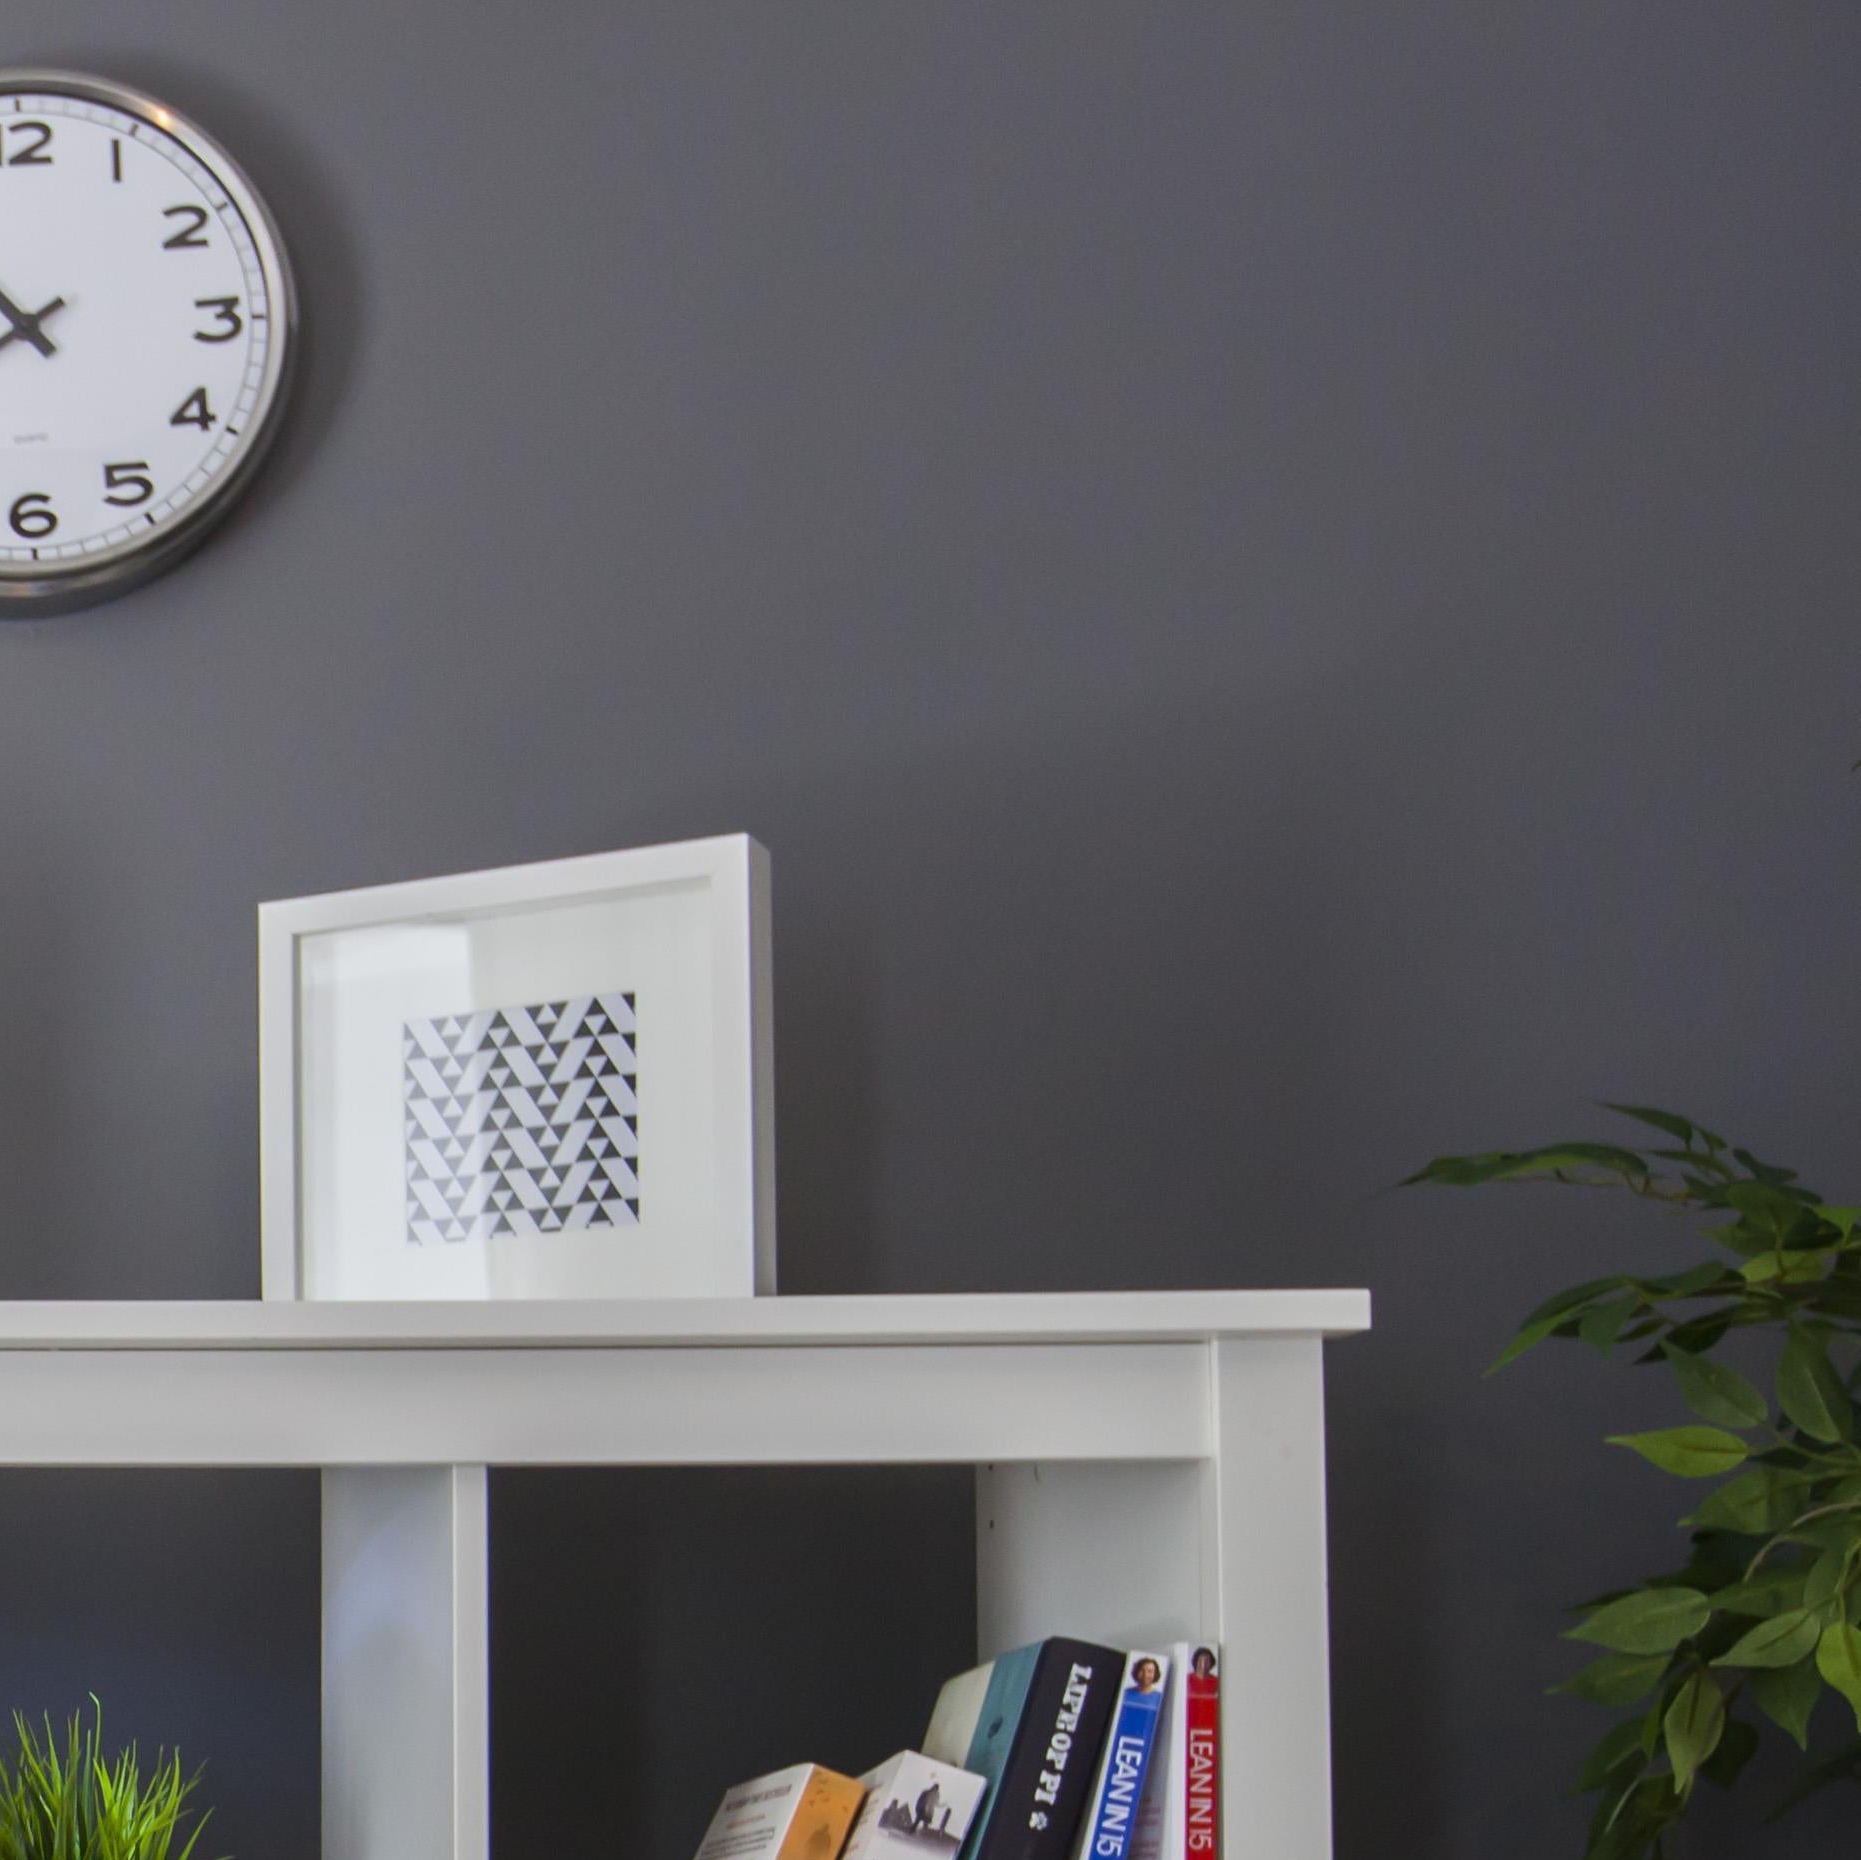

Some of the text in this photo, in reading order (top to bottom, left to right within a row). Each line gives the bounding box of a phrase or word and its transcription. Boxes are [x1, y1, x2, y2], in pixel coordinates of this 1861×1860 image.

[111, 138, 122, 183] 1
[162, 205, 209, 250] 2
[193, 296, 243, 343] 3
[169, 386, 217, 431] 4
[103, 461, 154, 507] 5
[8, 493, 58, 538] 6
[1034, 1663, 1092, 1807] LIFE OF PI
[1096, 1735, 1145, 1857] LEAN IN 15
[1188, 1728, 1213, 1851] LEAN IN 15
